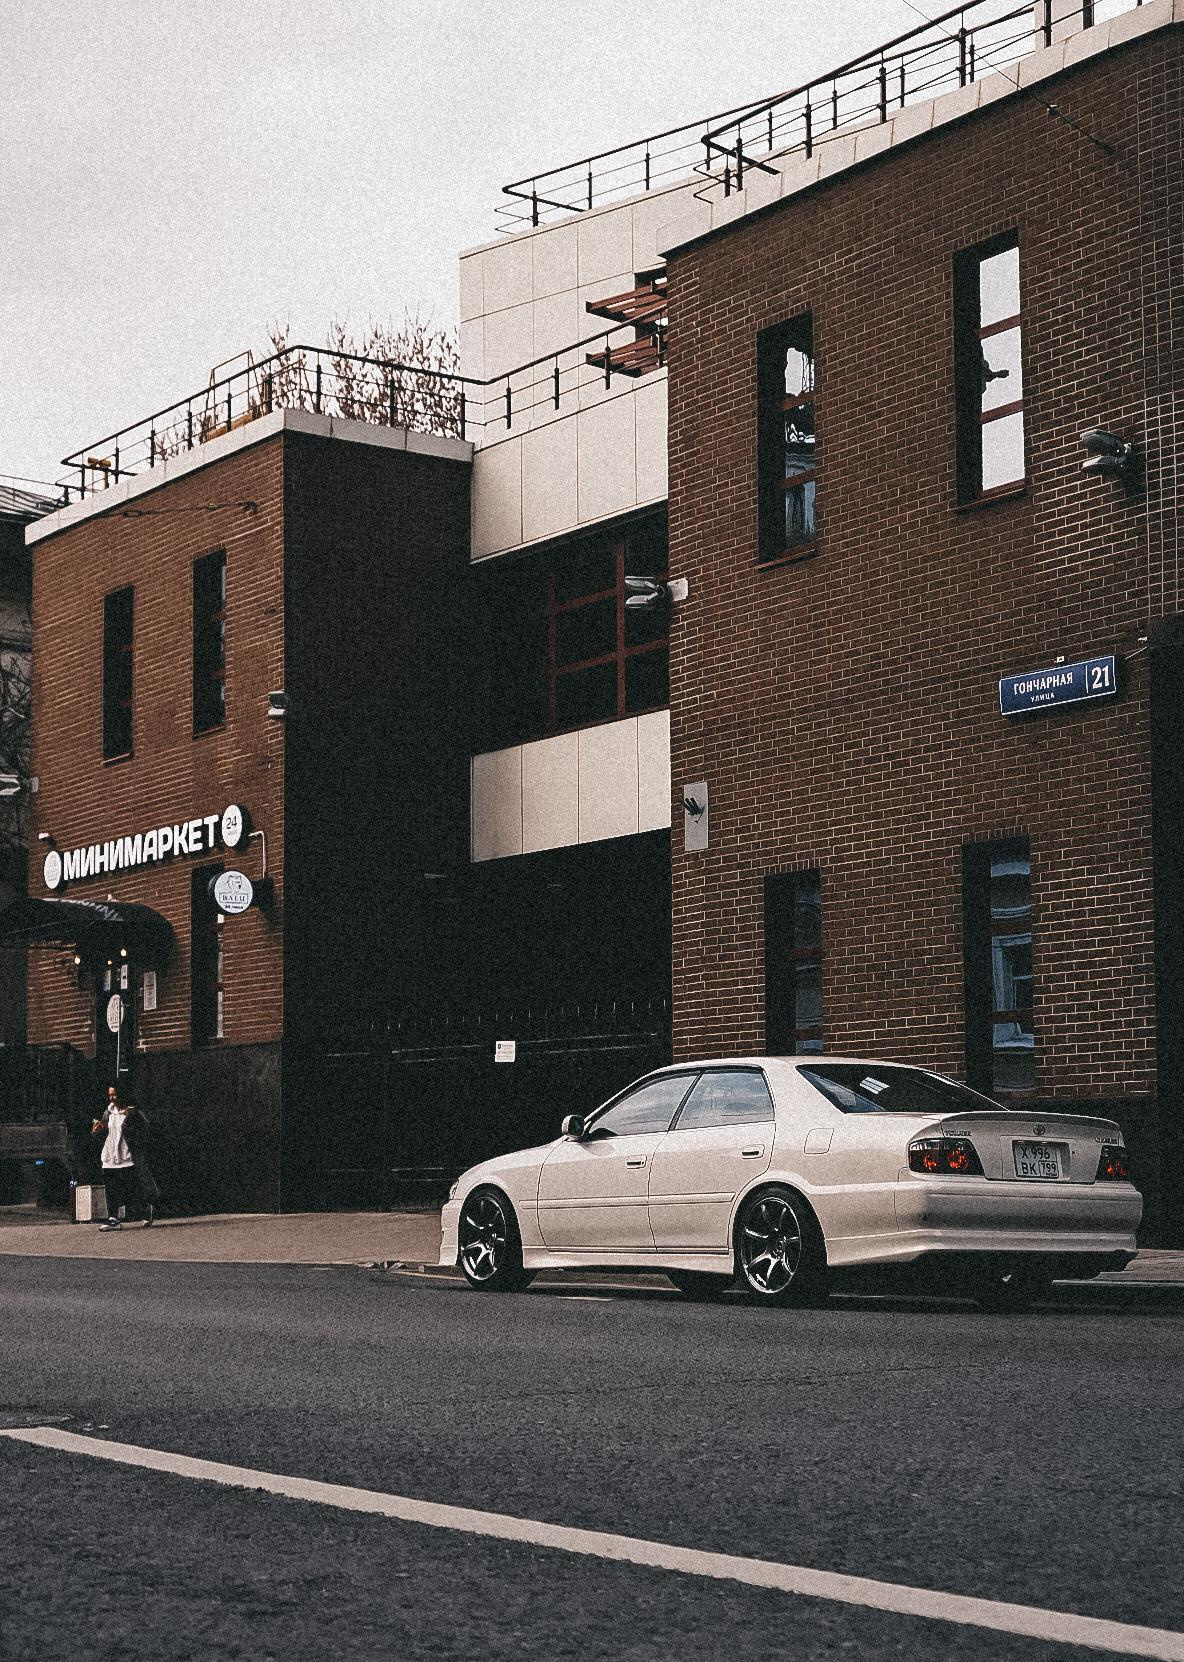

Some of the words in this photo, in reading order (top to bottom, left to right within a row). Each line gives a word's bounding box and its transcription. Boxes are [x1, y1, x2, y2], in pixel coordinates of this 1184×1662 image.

[1013, 671, 1073, 696] ГОНЧАРНАЯ
[1091, 664, 1110, 690] 21
[1030, 692, 1055, 703] УЛИЦА
[225, 815, 238, 830] 24
[63, 814, 220, 881] МИНИМАРКЕТ
[1031, 1146, 1051, 1159] 996
[1041, 1162, 1057, 1173] 799
